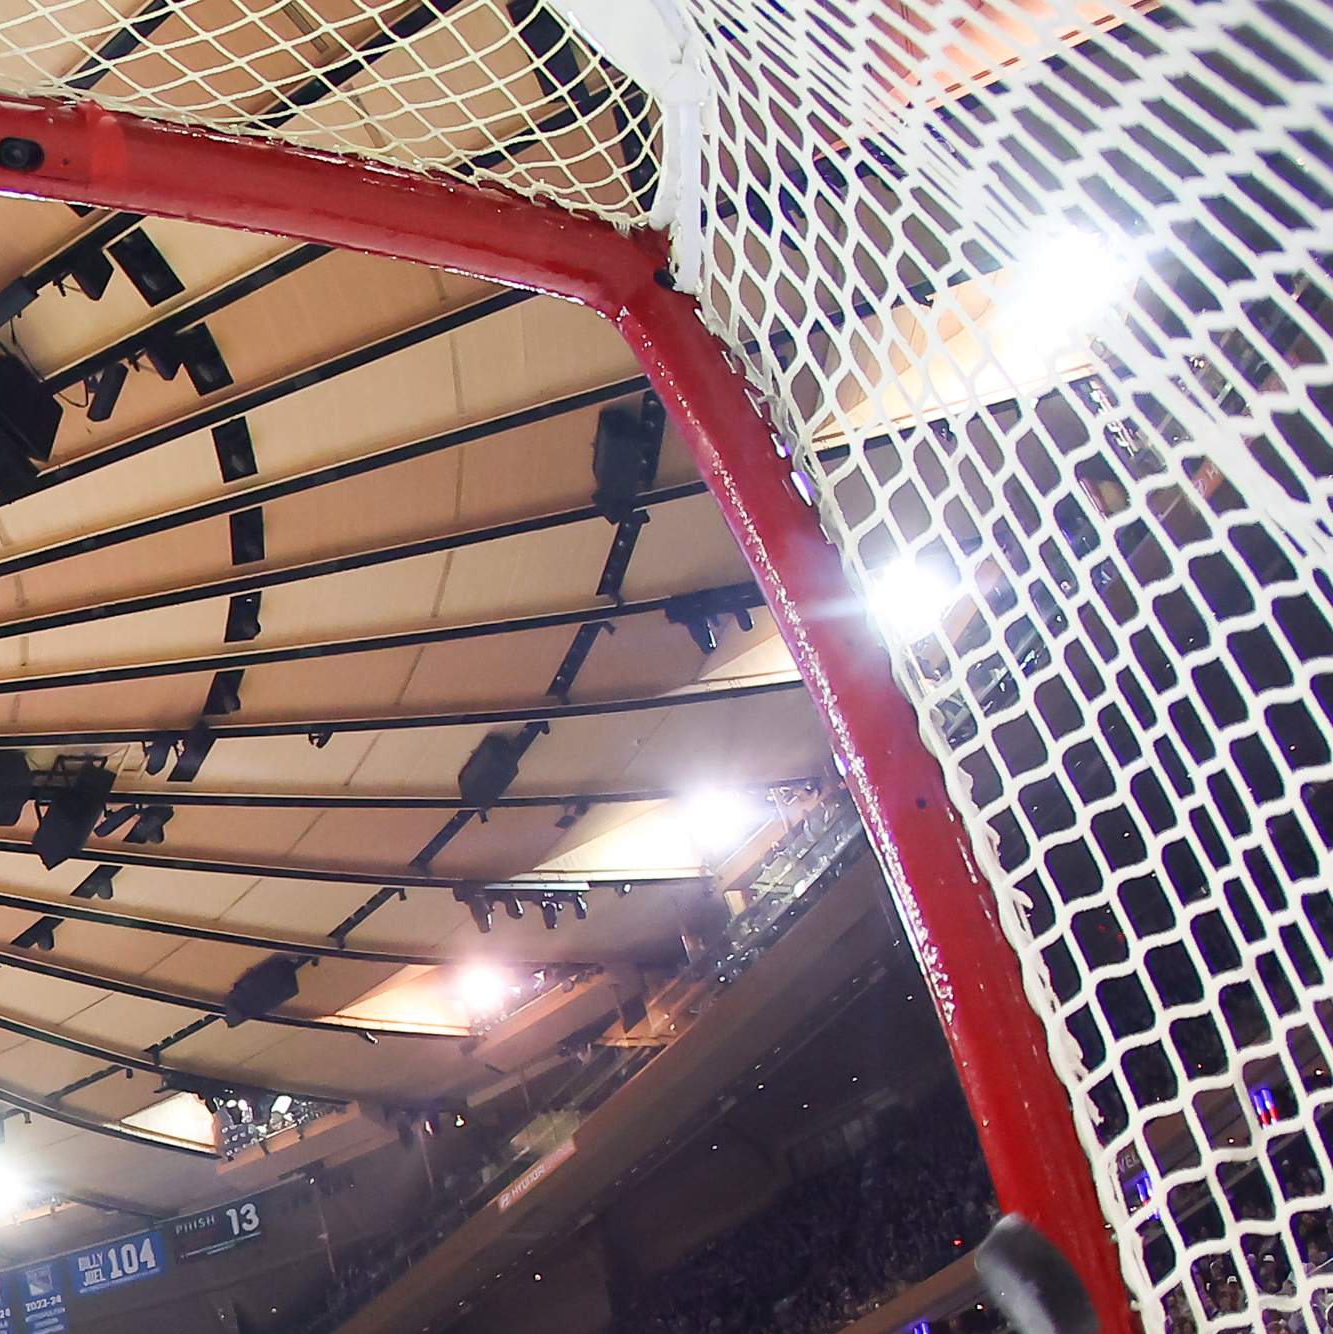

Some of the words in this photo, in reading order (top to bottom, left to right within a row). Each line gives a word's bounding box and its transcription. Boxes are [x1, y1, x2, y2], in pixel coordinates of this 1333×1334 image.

[226, 1203, 260, 1236] 13
[77, 1251, 105, 1272] BILLY
[107, 1238, 157, 1280] 104
[83, 1269, 107, 1287] JOEL
